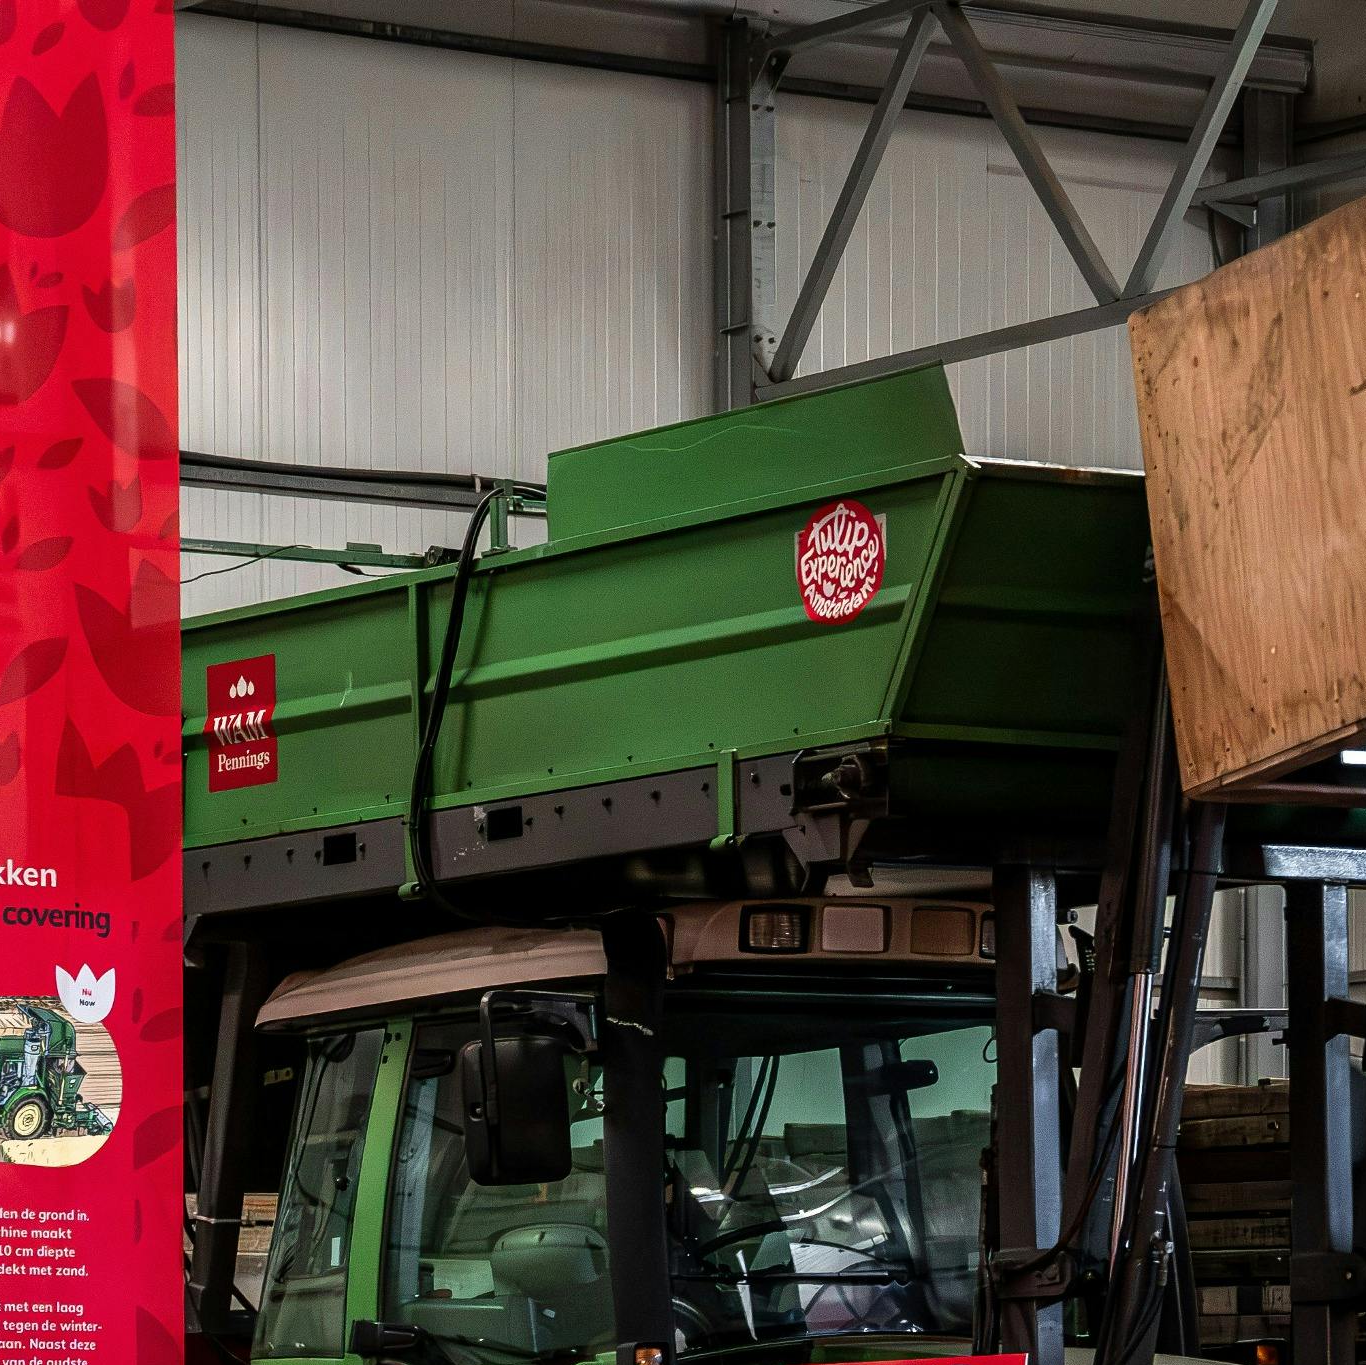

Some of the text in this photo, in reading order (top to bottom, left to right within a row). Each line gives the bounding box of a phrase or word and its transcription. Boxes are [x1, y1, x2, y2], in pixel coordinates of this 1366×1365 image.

[807, 502, 870, 561] Tulip
[800, 533, 880, 588] Experience
[804, 574, 877, 618] Amsterdam
[213, 709, 270, 746] WAM
[217, 749, 270, 772] Pennings
[2, 903, 111, 938] covering
[21, 1208, 35, 1219] de
[39, 1210, 74, 1223] grond
[78, 1210, 89, 1221] in.
[31, 1228, 71, 1239] maakt
[15, 1248, 33, 1256] cm
[37, 1246, 75, 1260] diepte
[30, 1266, 52, 1275] met
[56, 1265, 88, 1276] zand.
